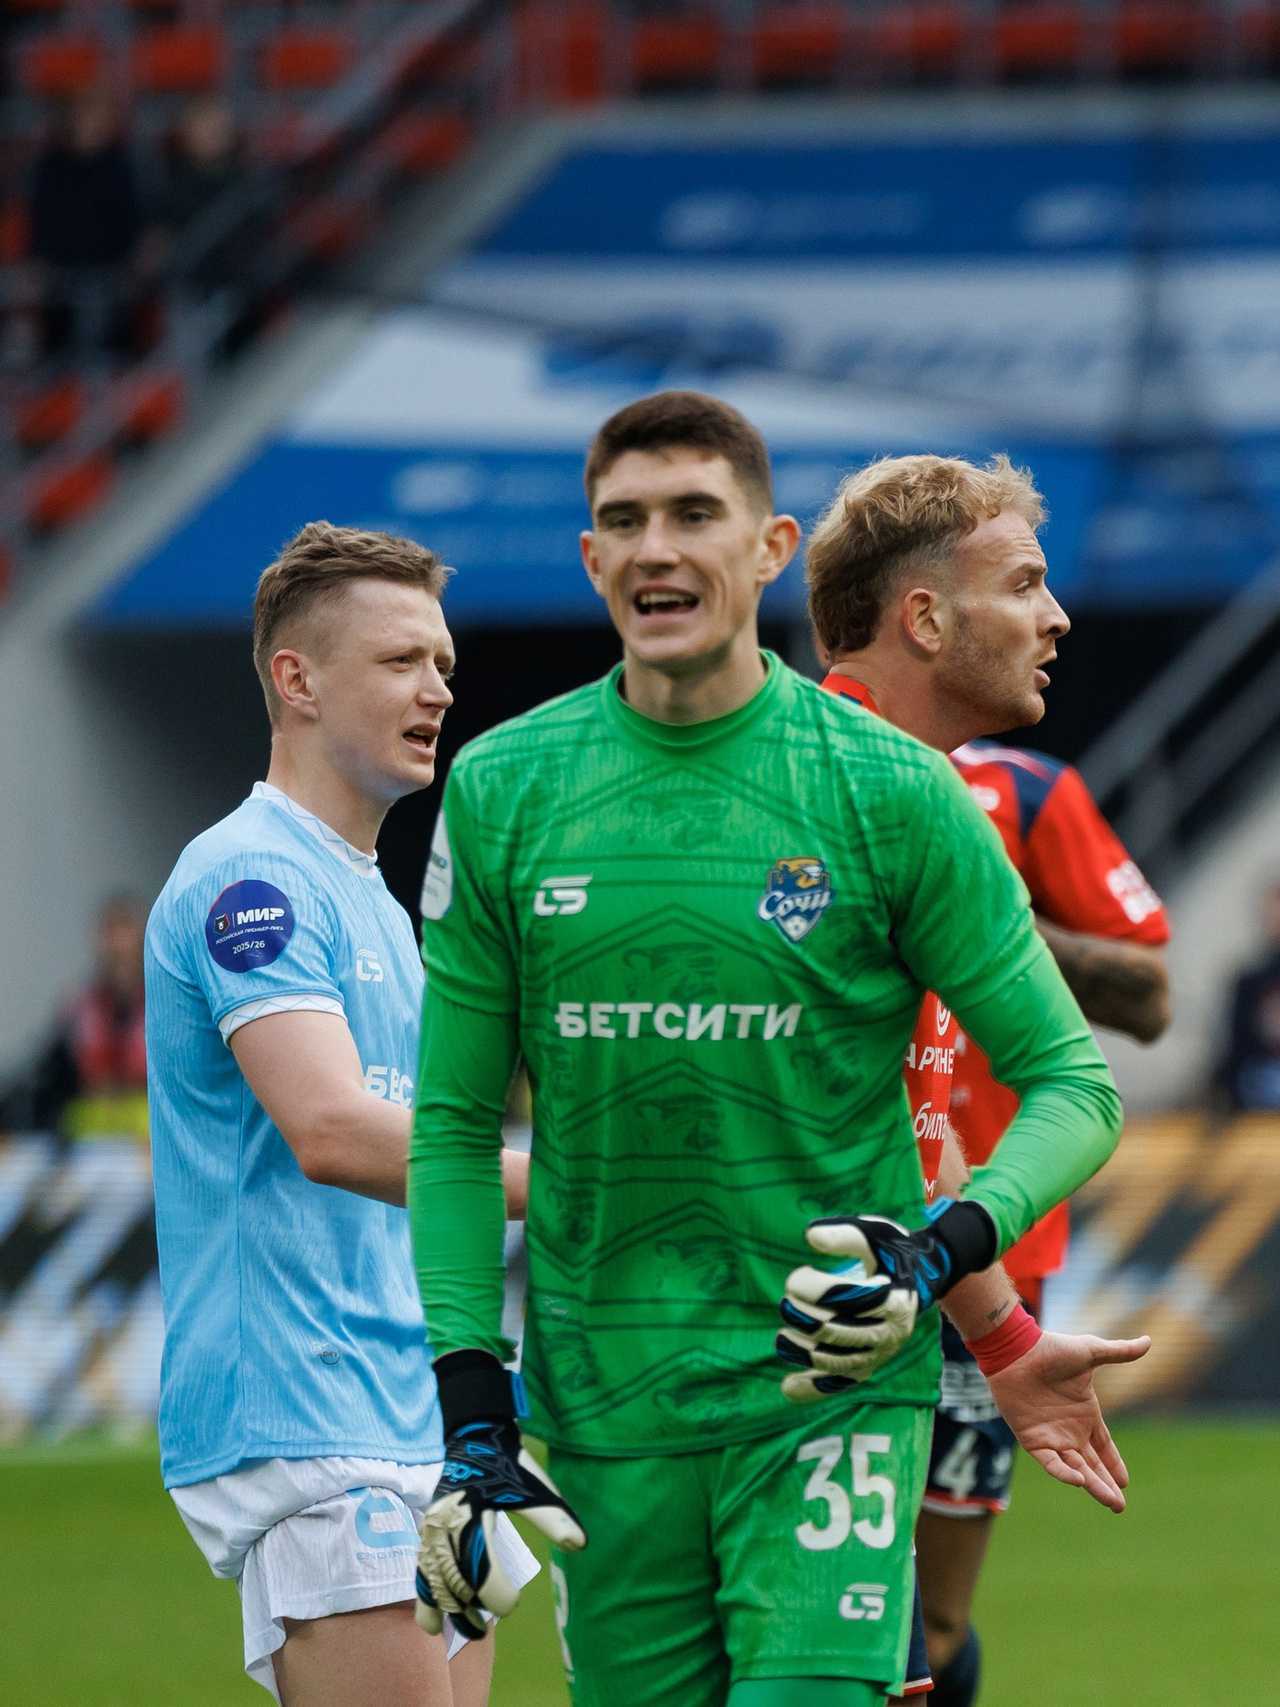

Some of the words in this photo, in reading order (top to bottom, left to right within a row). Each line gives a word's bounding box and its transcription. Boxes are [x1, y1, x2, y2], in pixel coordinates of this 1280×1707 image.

[236, 907, 285, 925] МИР
[244, 925, 284, 934] ПРЕМЬЕР-ЛИГА
[232, 940, 265, 954] 2025/26
[555, 1002, 802, 1041] БЕТСИТИ
[795, 1432, 896, 1551] 35
